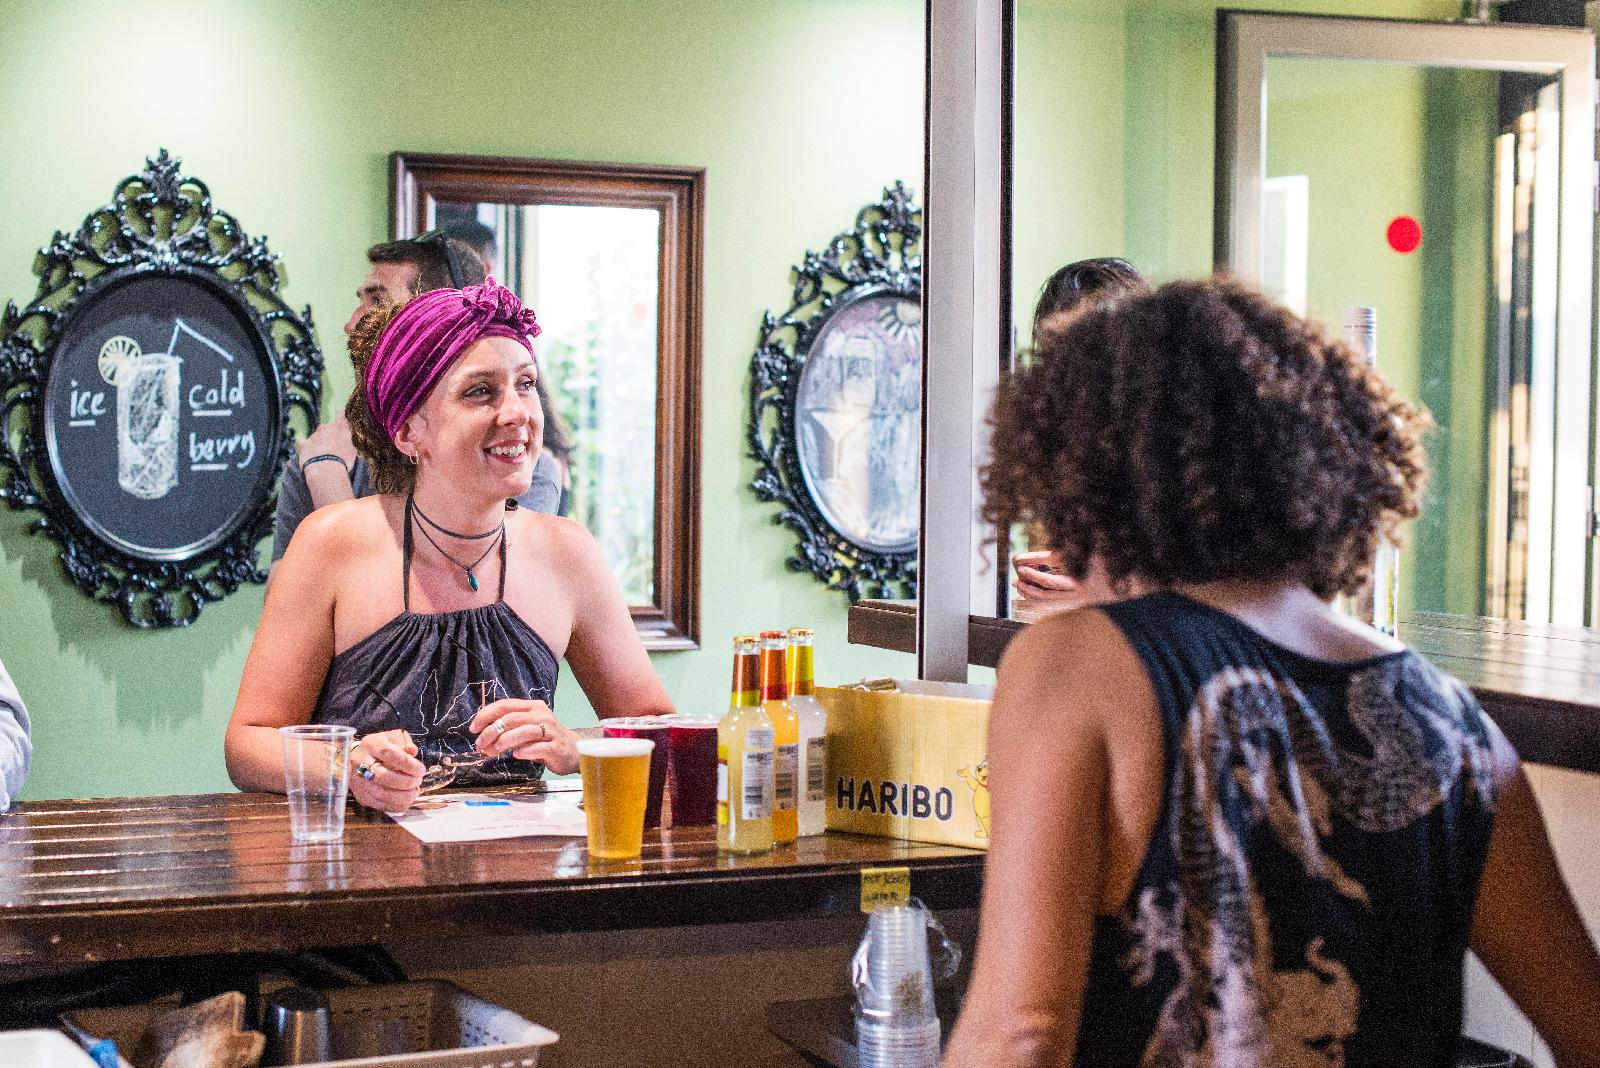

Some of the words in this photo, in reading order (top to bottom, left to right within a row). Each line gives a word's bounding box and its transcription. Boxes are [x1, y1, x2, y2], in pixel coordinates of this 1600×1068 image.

[69, 380, 106, 417] ice
[189, 430, 256, 469] berry
[836, 777, 954, 821] HARIBO
